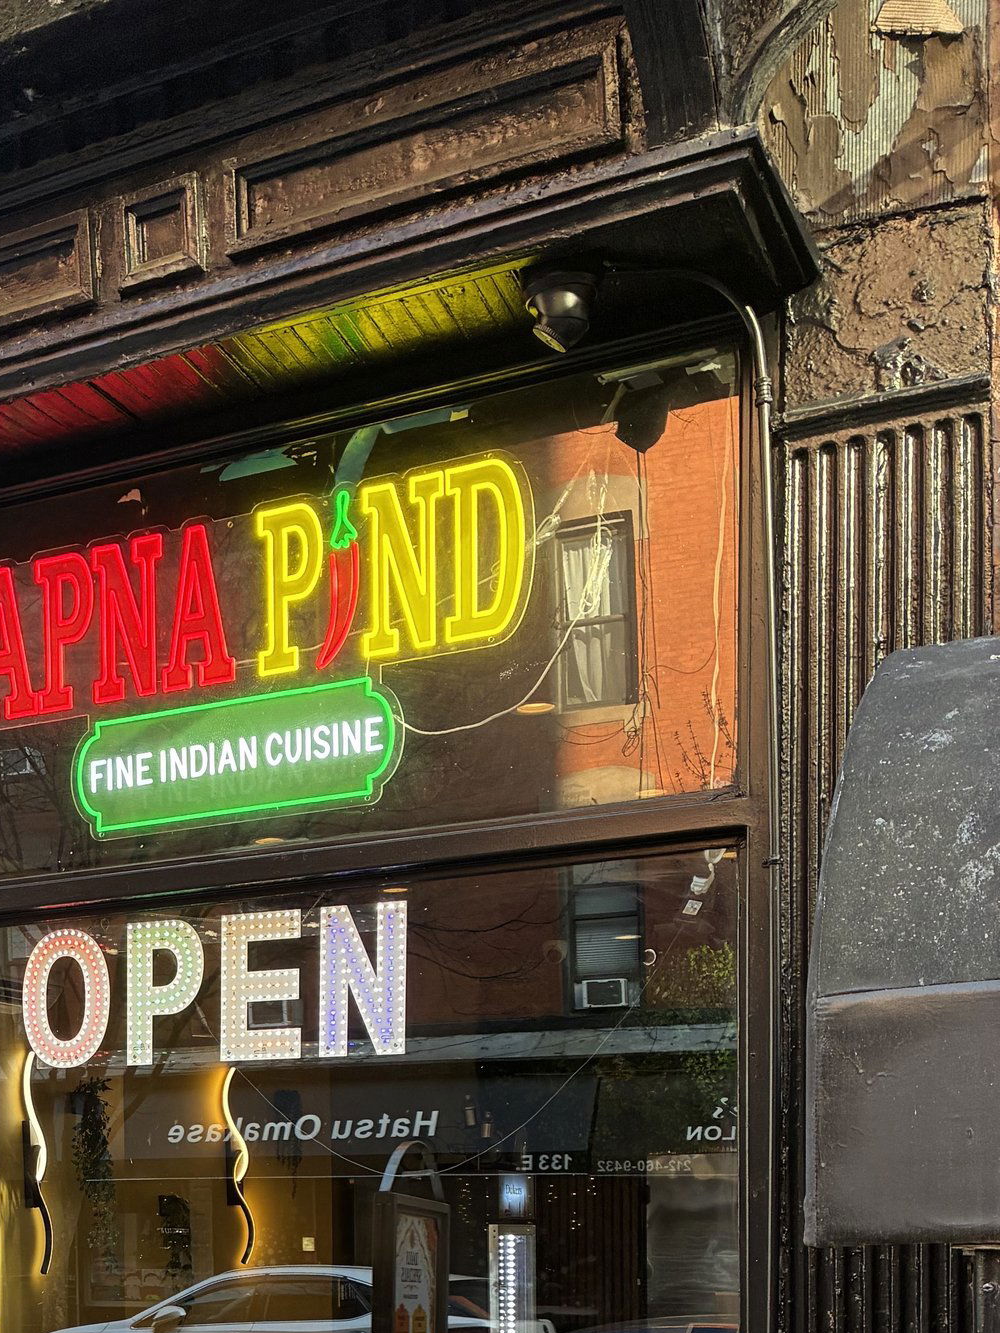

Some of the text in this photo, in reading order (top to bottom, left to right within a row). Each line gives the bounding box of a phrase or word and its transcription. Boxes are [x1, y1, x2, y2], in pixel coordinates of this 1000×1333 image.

[89, 716, 384, 793] FINE INDIAN CUISINE
[22, 900, 408, 1069] OPEN
